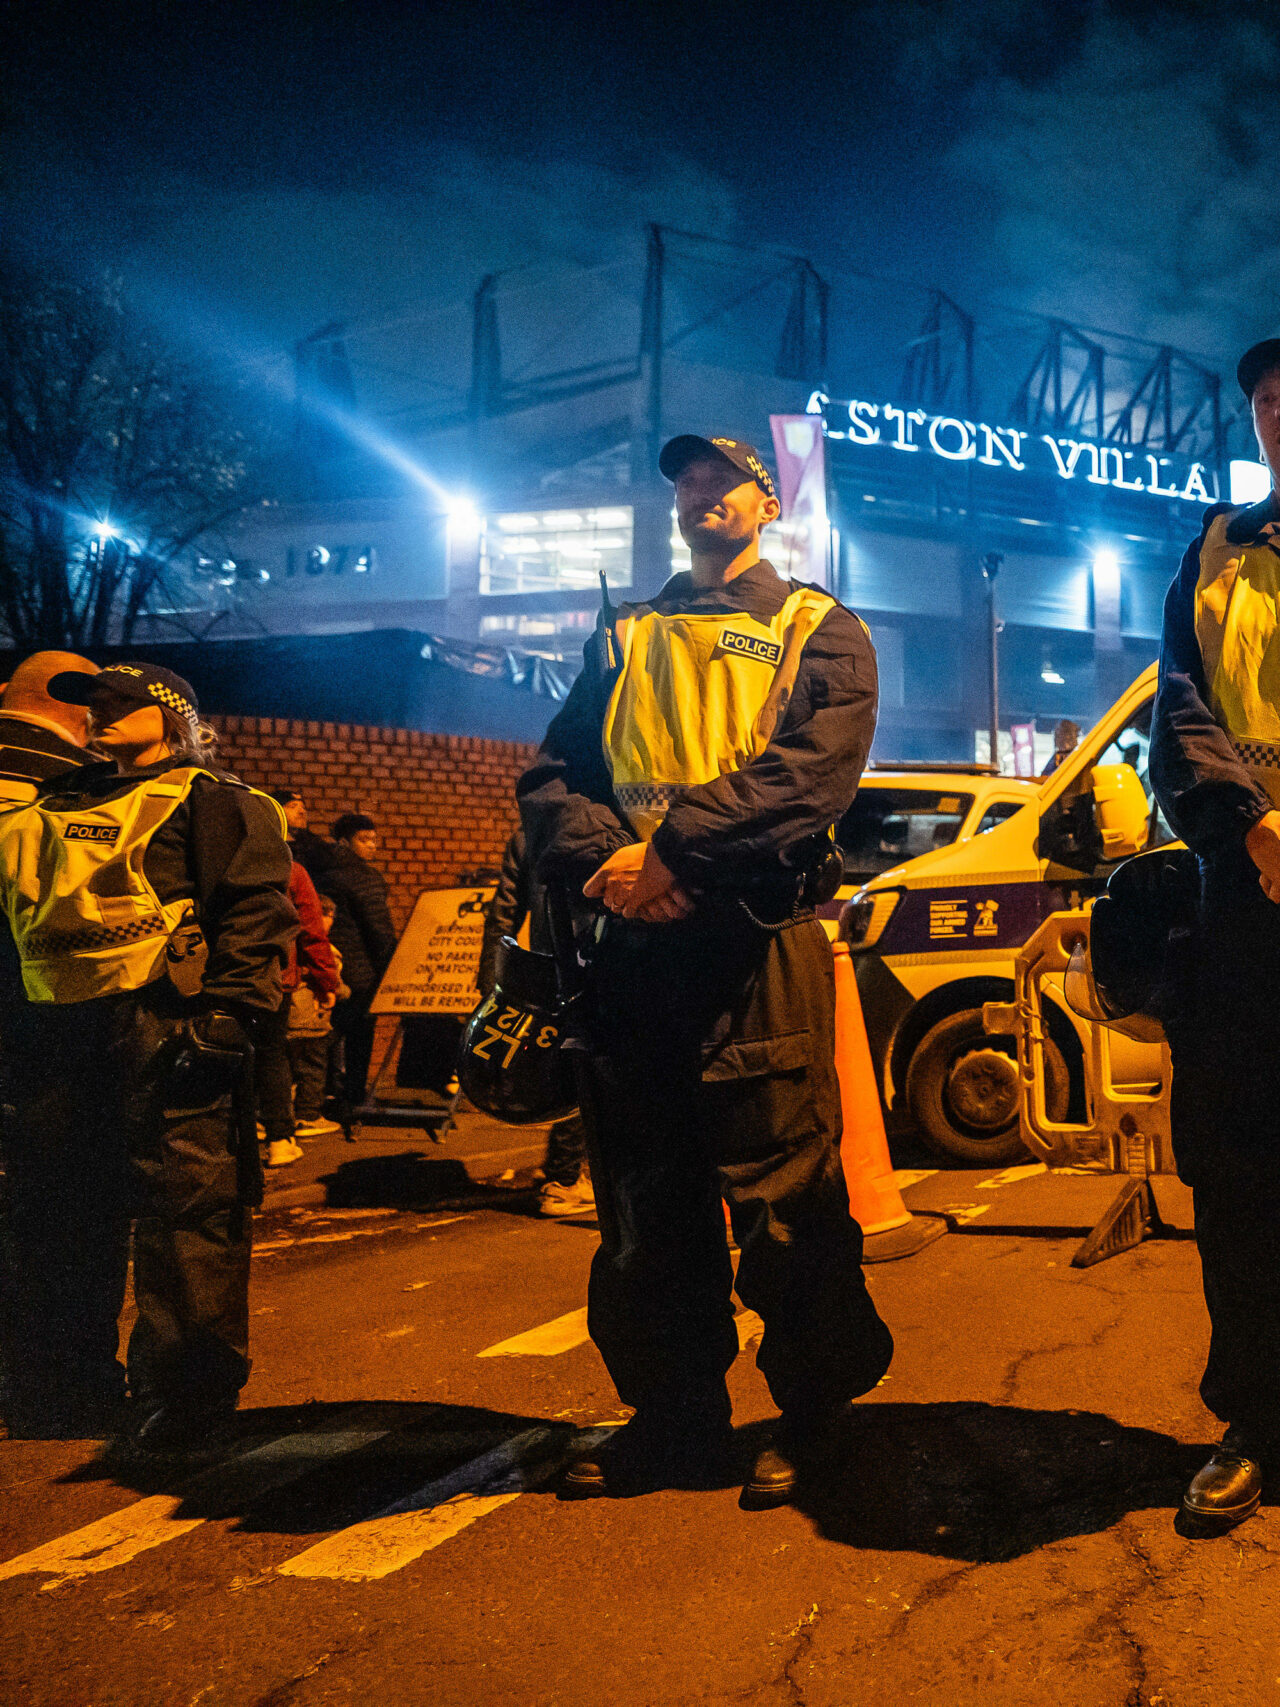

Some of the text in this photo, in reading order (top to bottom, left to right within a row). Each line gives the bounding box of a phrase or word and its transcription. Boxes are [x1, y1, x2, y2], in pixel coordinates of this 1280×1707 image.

[1043, 434, 1219, 504] VILLA
[723, 633, 778, 660] POLICE
[104, 664, 144, 678] LICE
[67, 825, 118, 839] POLICE
[420, 996, 435, 1007] BE
[438, 996, 478, 1008] REMOV
[472, 1025, 521, 1070] LZ
